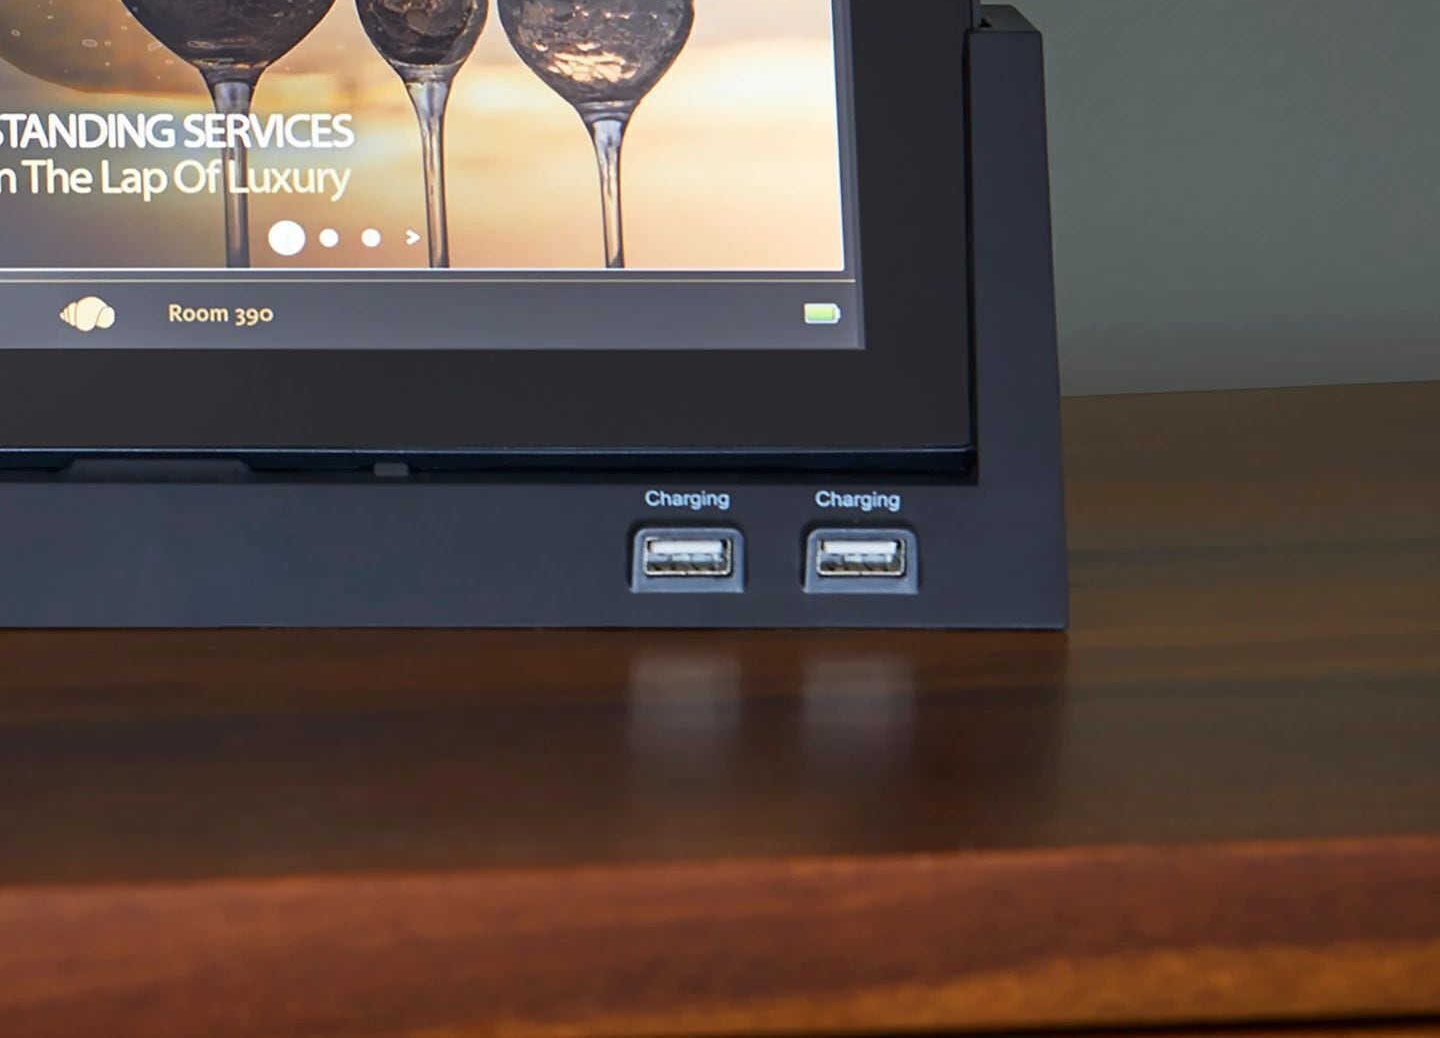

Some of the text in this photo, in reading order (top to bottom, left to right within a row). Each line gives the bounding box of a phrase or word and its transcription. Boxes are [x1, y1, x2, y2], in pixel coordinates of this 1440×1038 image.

[183, 113, 355, 149] SERVICES
[21, 160, 93, 194] The
[100, 160, 168, 202] Lap
[174, 159, 223, 194] Of
[230, 162, 351, 201] Luxury
[168, 304, 274, 326] Room 390
[645, 490, 730, 509] Charging
[815, 490, 901, 512] Charging
